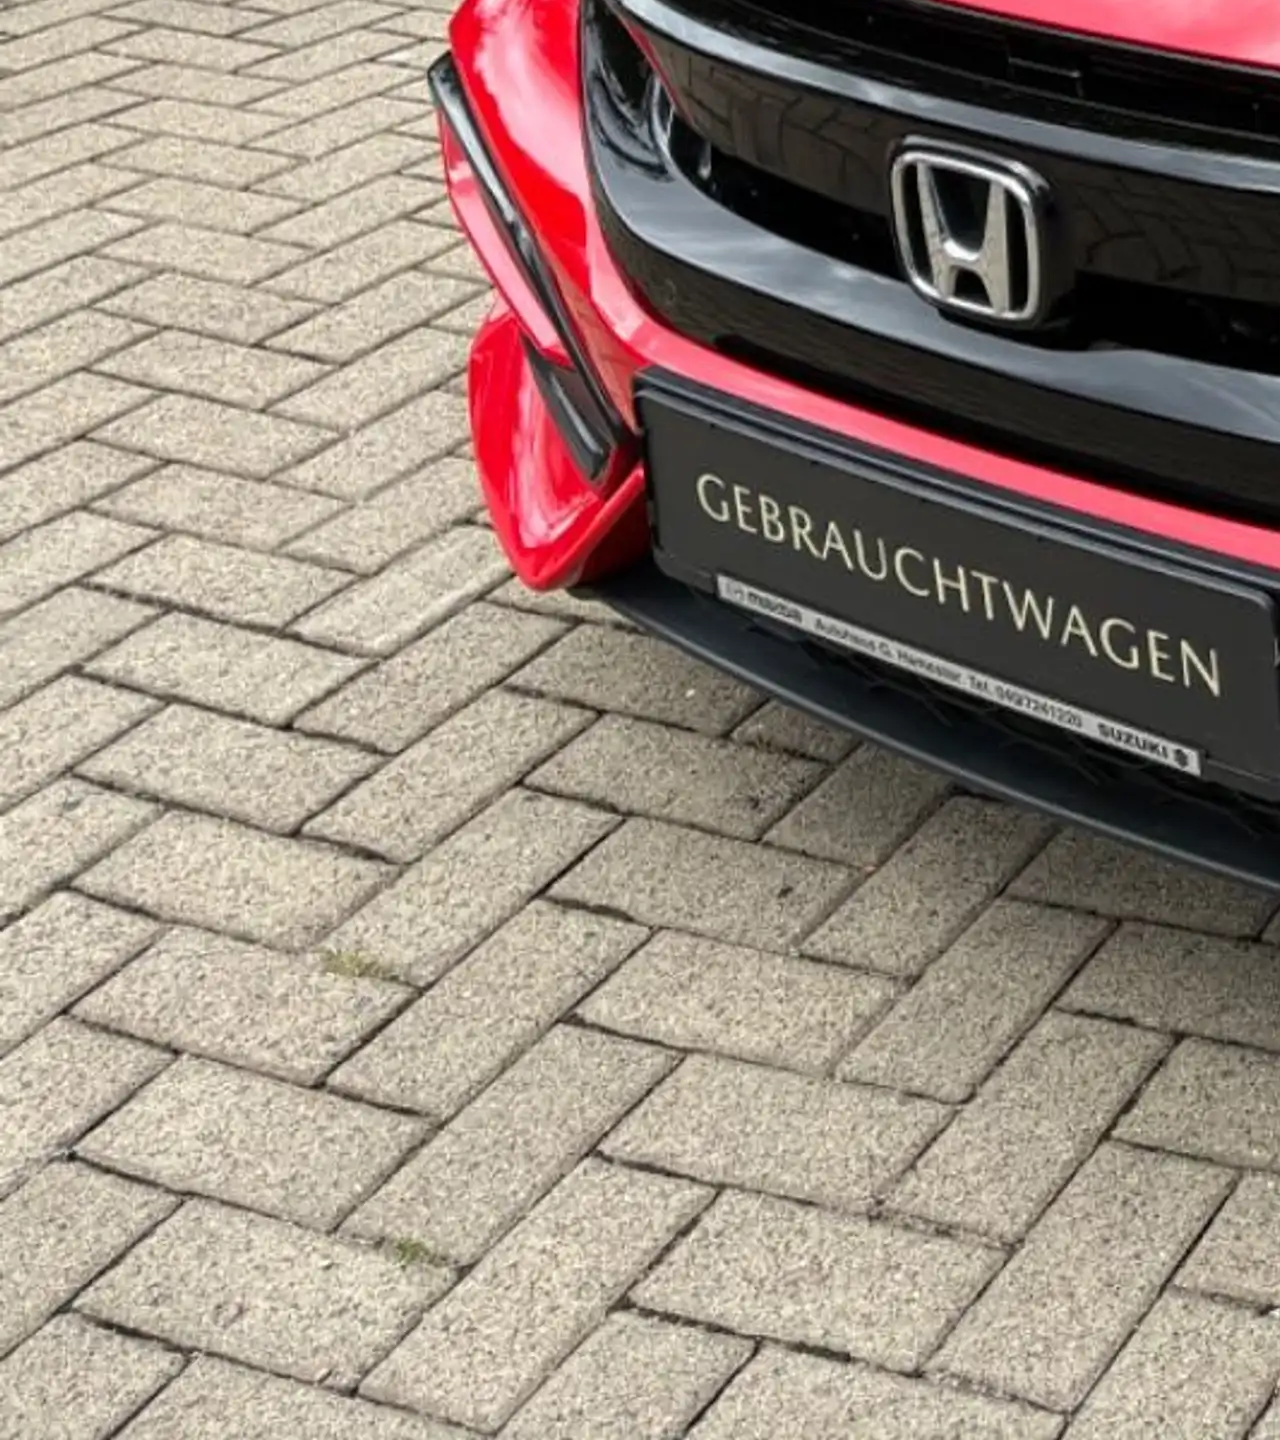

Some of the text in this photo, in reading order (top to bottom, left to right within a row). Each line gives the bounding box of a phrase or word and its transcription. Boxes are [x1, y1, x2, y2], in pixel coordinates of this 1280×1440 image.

[696, 473, 1222, 697] GEBRAUCHTWAGEN
[814, 617, 876, 652] Autohaus
[1097, 722, 1169, 760] SUZUKI
